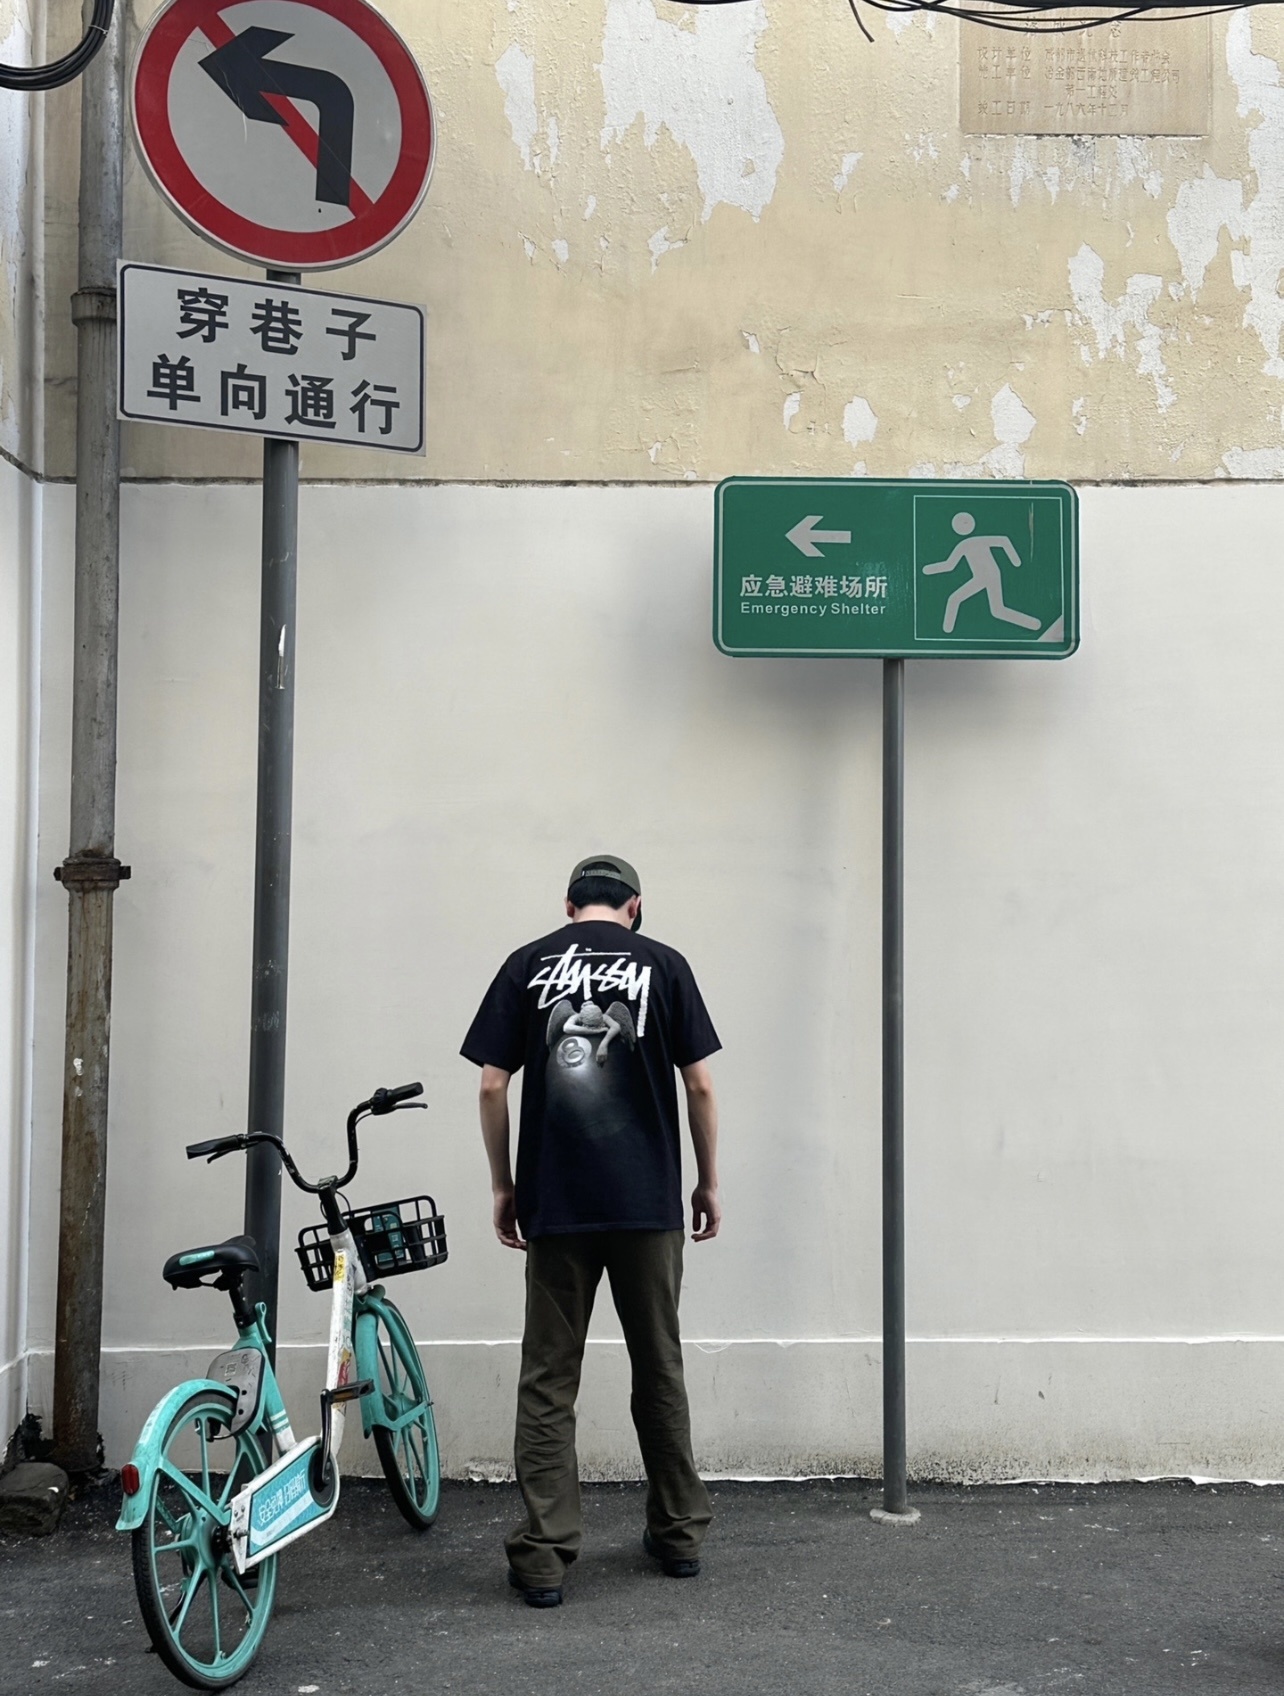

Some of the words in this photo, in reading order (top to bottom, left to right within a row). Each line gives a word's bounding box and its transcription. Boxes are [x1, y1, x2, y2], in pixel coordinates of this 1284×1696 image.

[1043, 101, 1129, 118] 一九八六年十二月
[176, 287, 377, 361] 穿巷子
[147, 353, 400, 435] 单向通行
[740, 574, 887, 598] 应急避难场所
[740, 602, 827, 617] Emergency
[831, 602, 886, 615] Shelter
